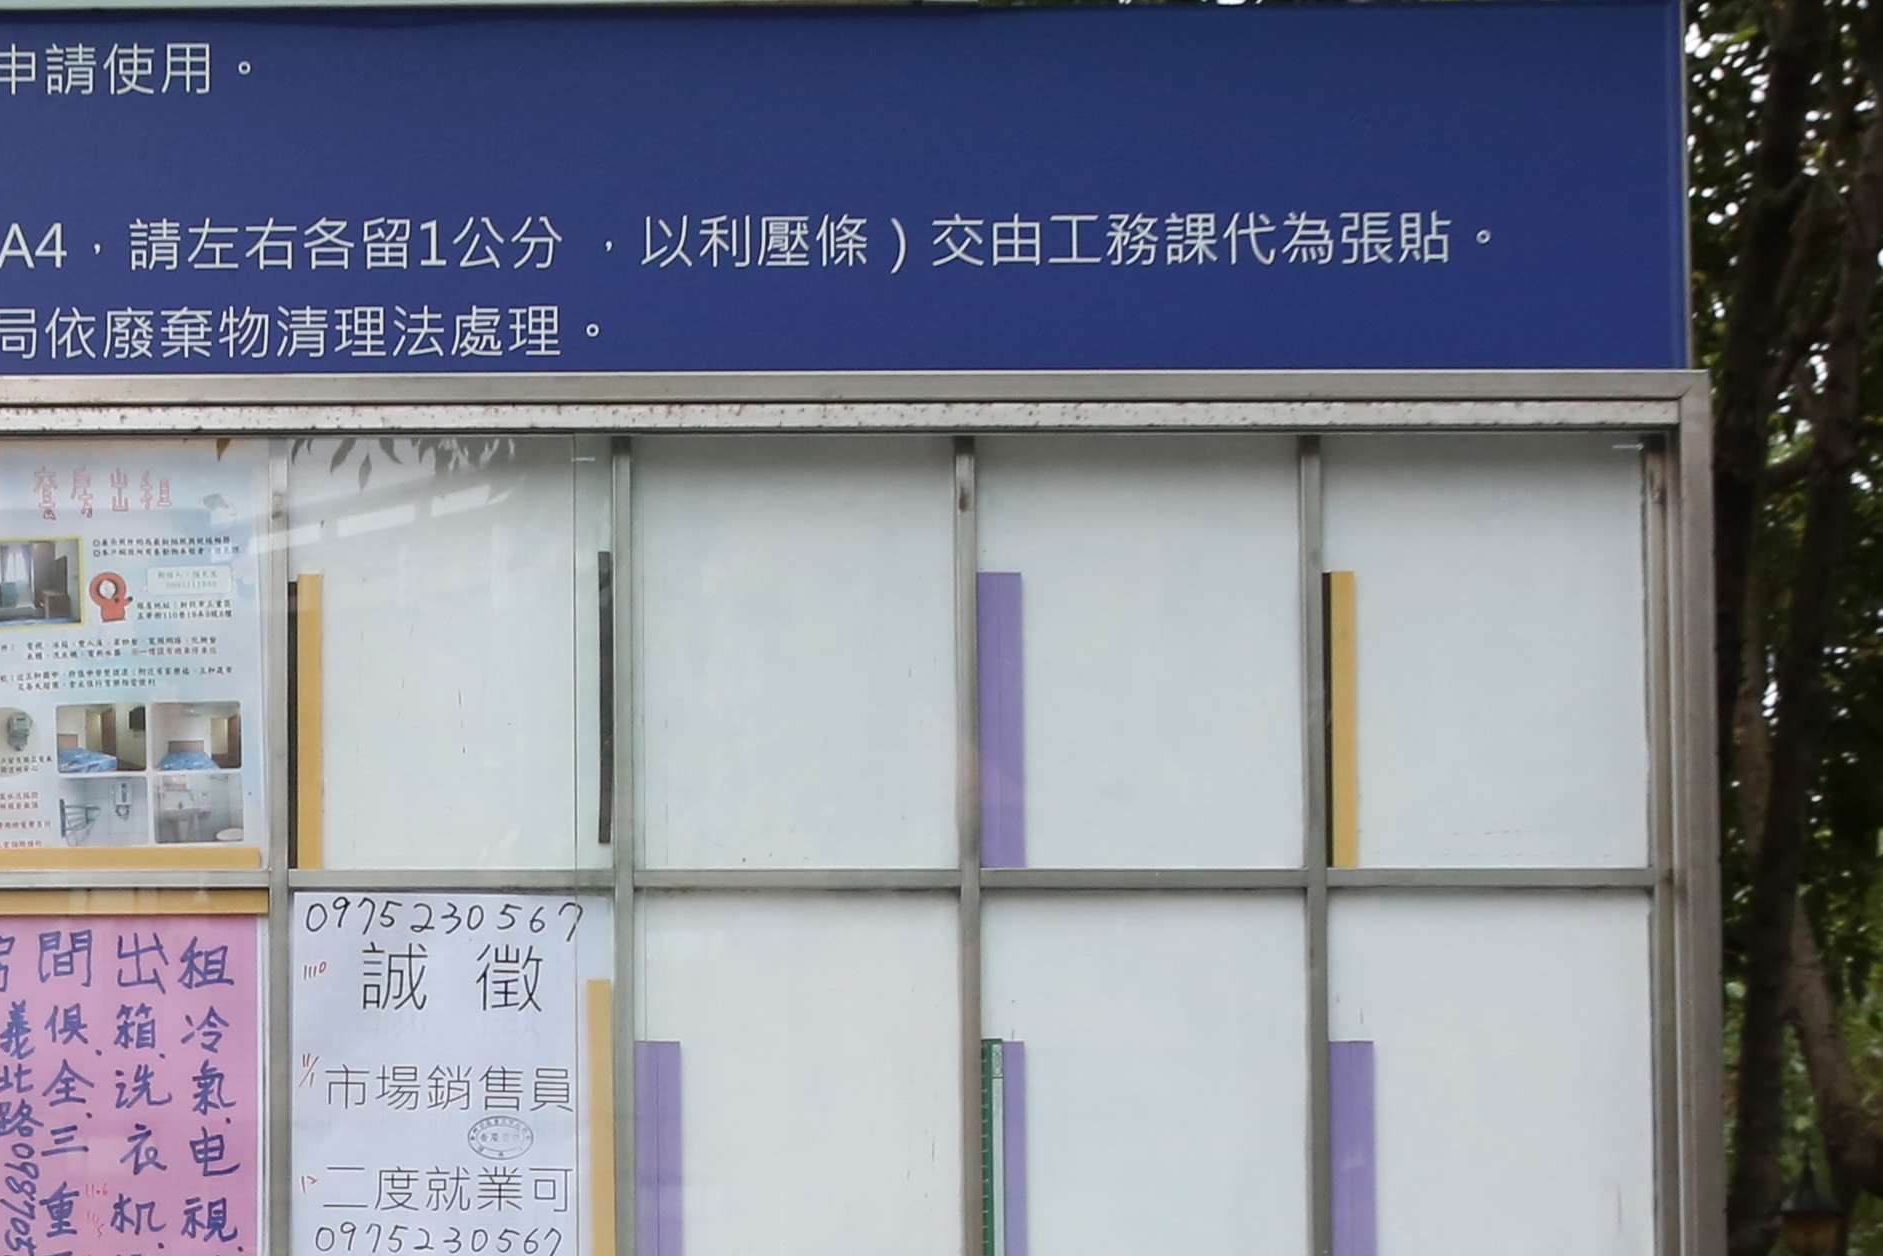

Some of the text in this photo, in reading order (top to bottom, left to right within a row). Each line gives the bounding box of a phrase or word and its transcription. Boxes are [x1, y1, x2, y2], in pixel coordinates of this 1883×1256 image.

[33, 465, 173, 521] 套房出租
[305, 895, 585, 943] 0975230567
[324, 1064, 575, 1113] 市場銷售員
[322, 1165, 574, 1213] 二度就業可
